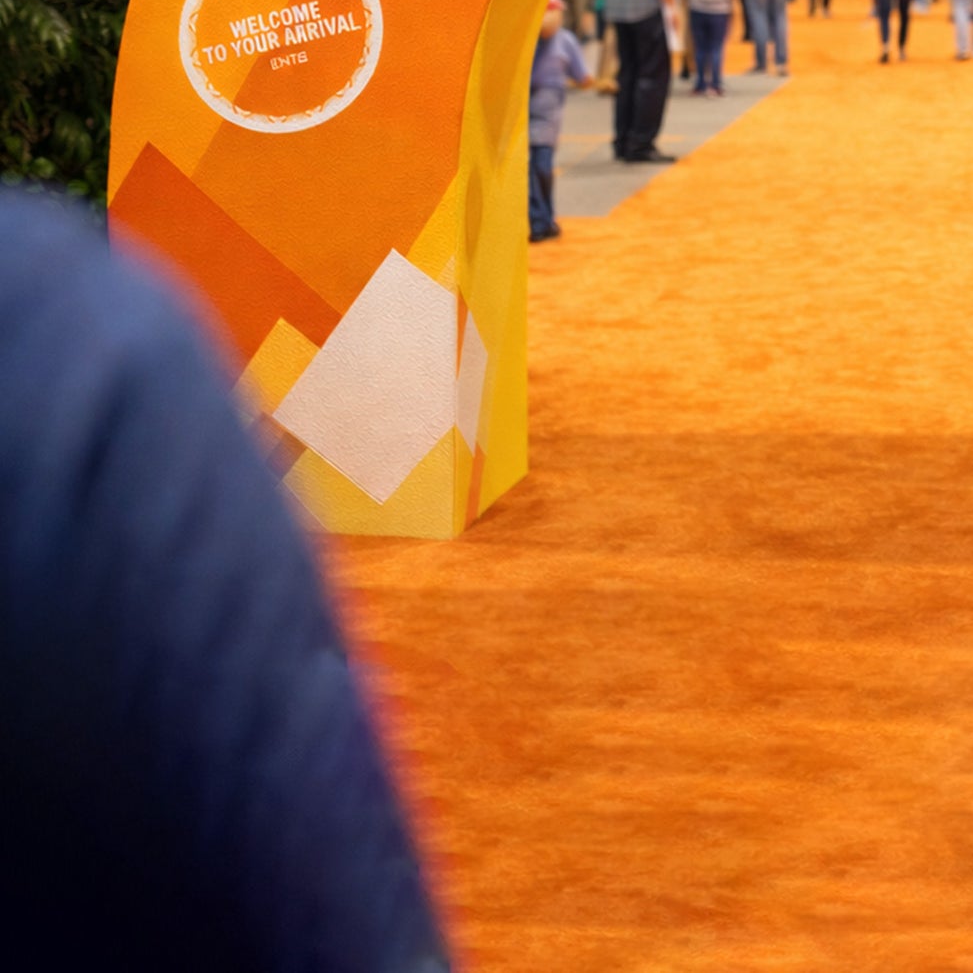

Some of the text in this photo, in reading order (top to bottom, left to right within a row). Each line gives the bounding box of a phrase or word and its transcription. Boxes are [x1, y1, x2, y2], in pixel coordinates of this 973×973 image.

[229, 1, 321, 38] WELCOME
[202, 40, 227, 64] TO
[231, 31, 281, 58] YOUR
